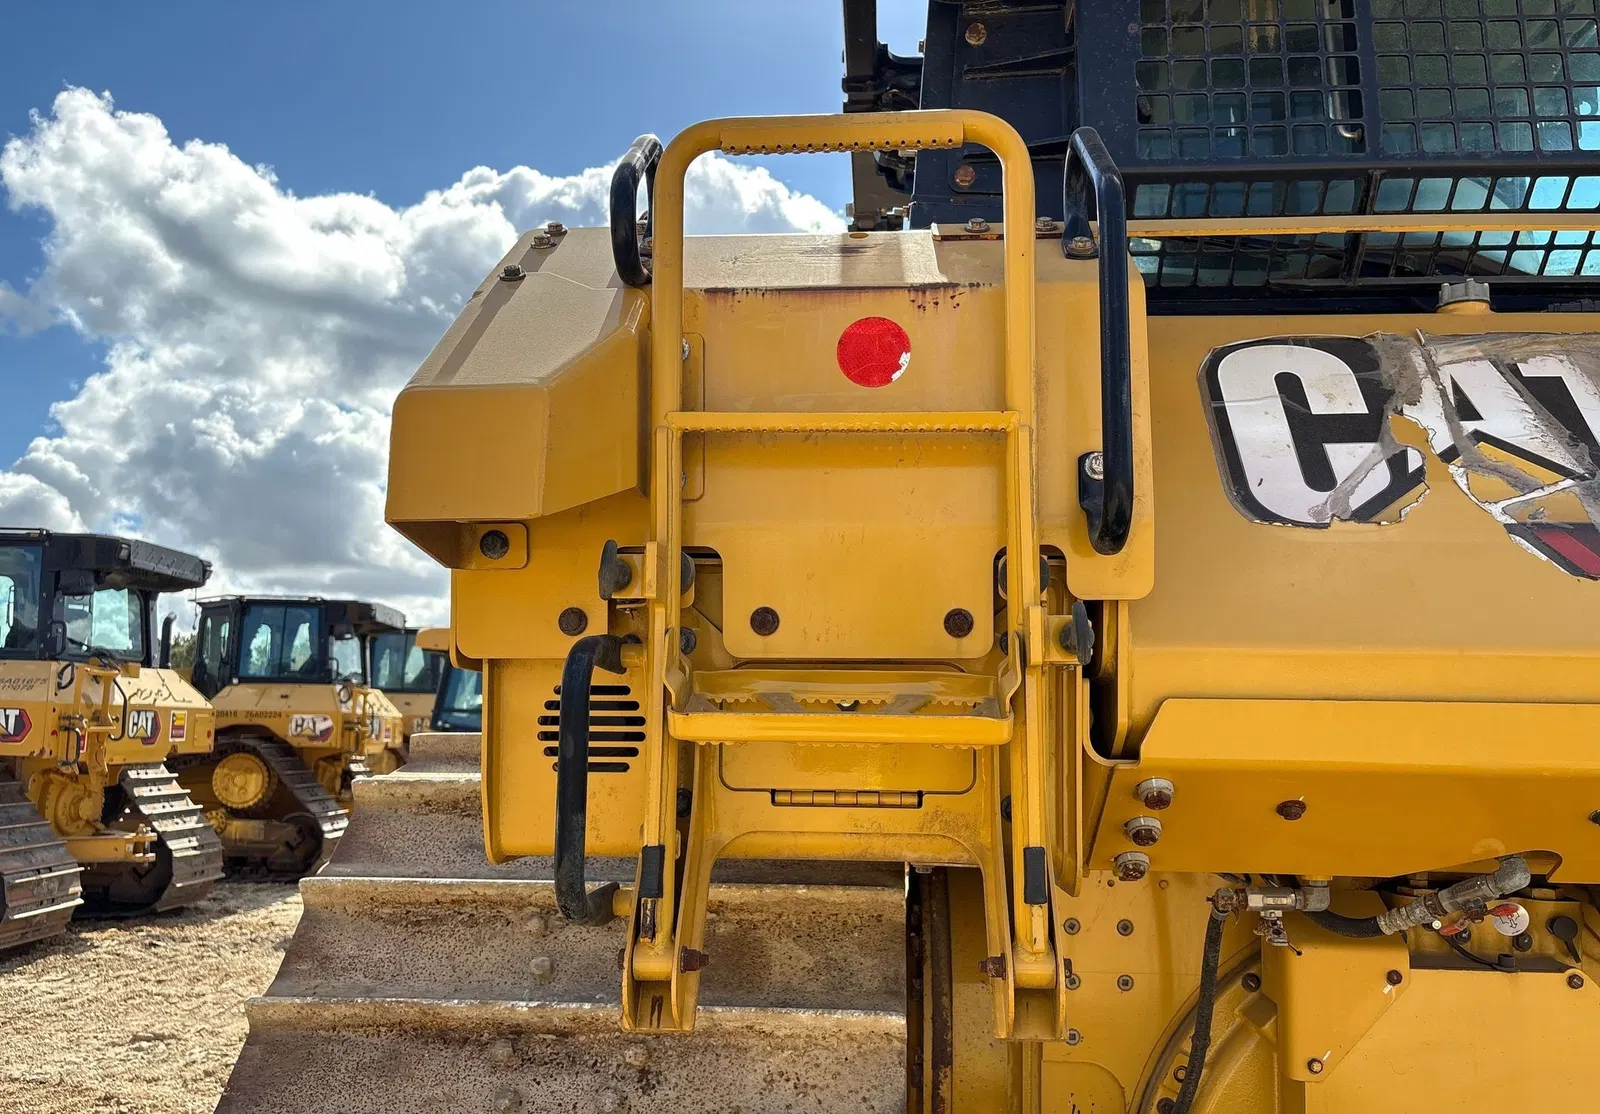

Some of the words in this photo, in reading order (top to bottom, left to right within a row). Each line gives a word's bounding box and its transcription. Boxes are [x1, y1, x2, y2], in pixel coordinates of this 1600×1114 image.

[0, 709, 19, 735] AT
[128, 710, 155, 738] CAT
[290, 715, 324, 736] CAT
